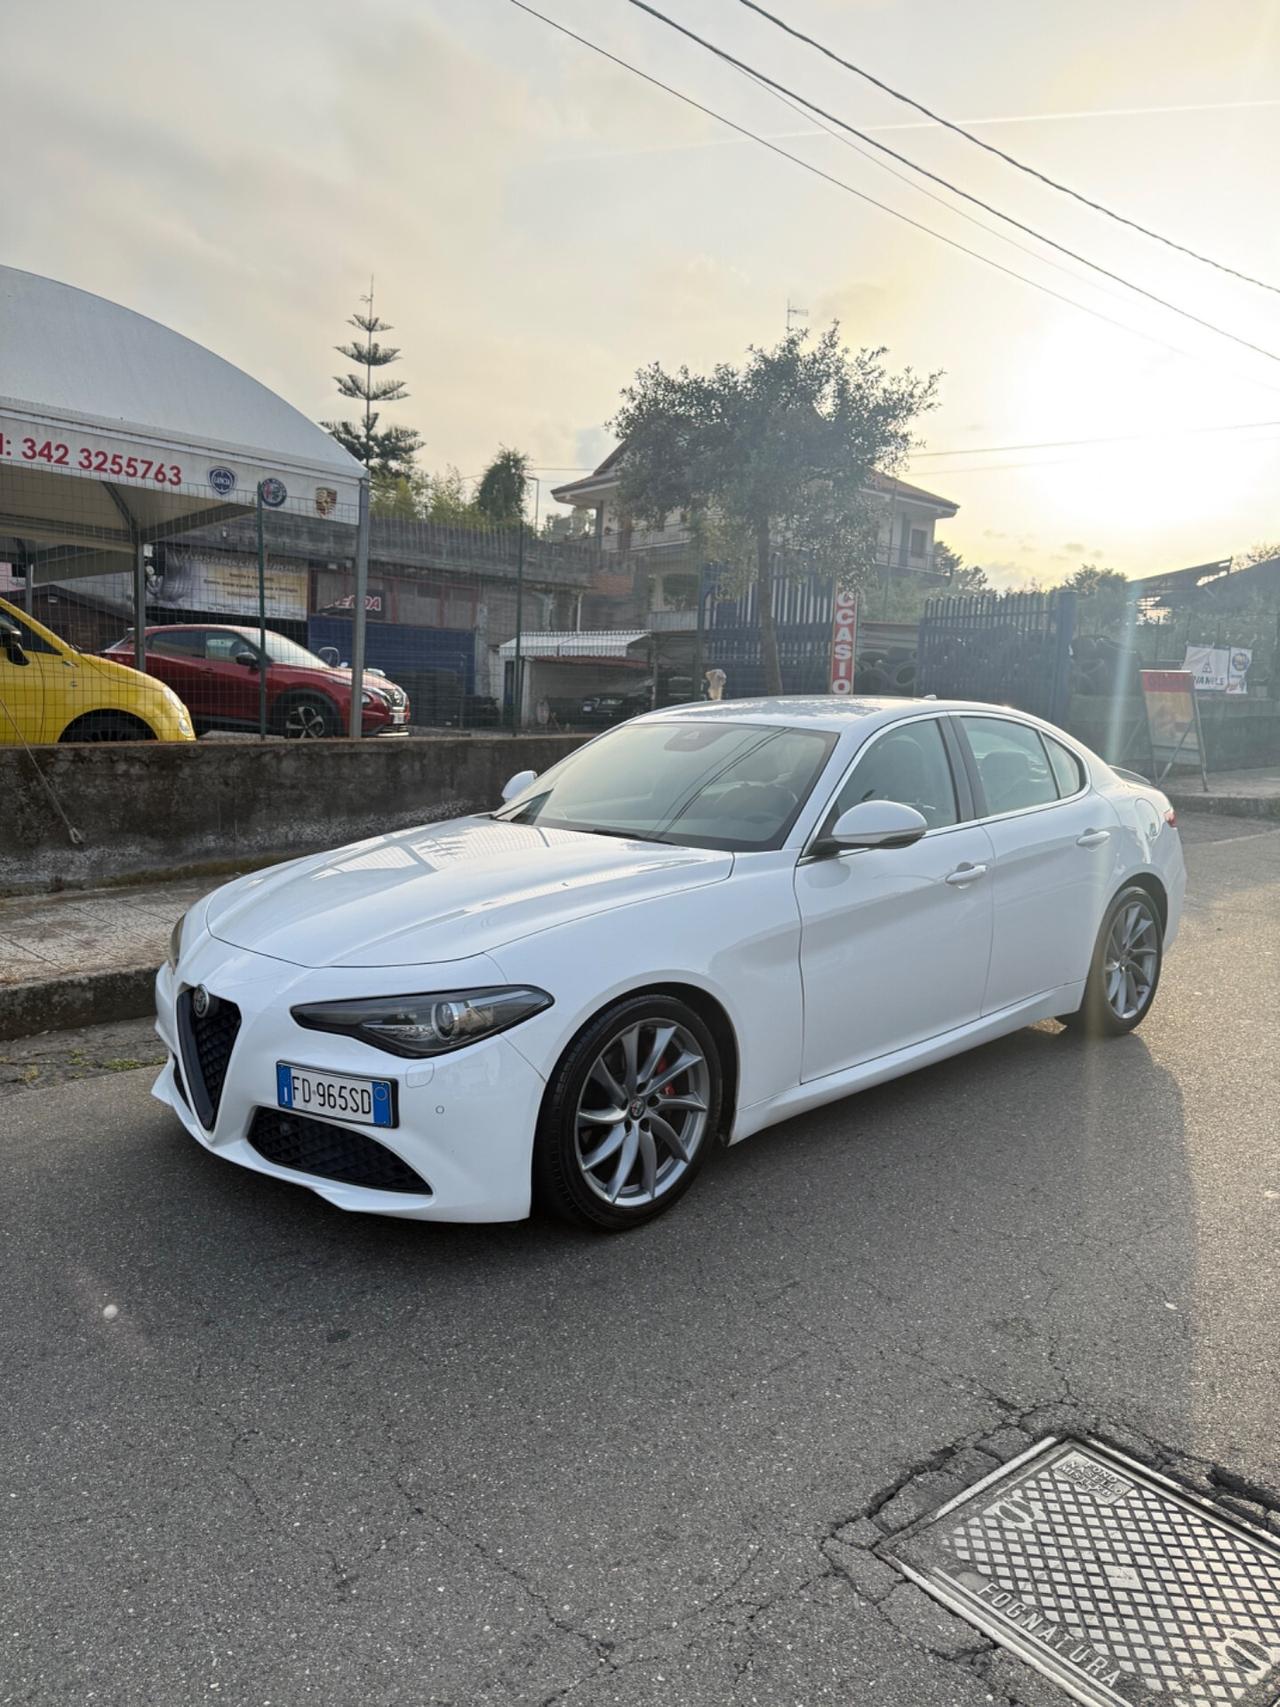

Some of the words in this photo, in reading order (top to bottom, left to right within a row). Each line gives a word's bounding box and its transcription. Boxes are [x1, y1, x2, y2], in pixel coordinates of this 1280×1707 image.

[21, 437, 70, 466] 342
[78, 448, 182, 486] 3255763
[832, 591, 856, 694] CCASIO
[292, 1076, 312, 1103] FD
[316, 1082, 372, 1115] 965SD
[977, 1583, 1121, 1687] FOGNATURA
